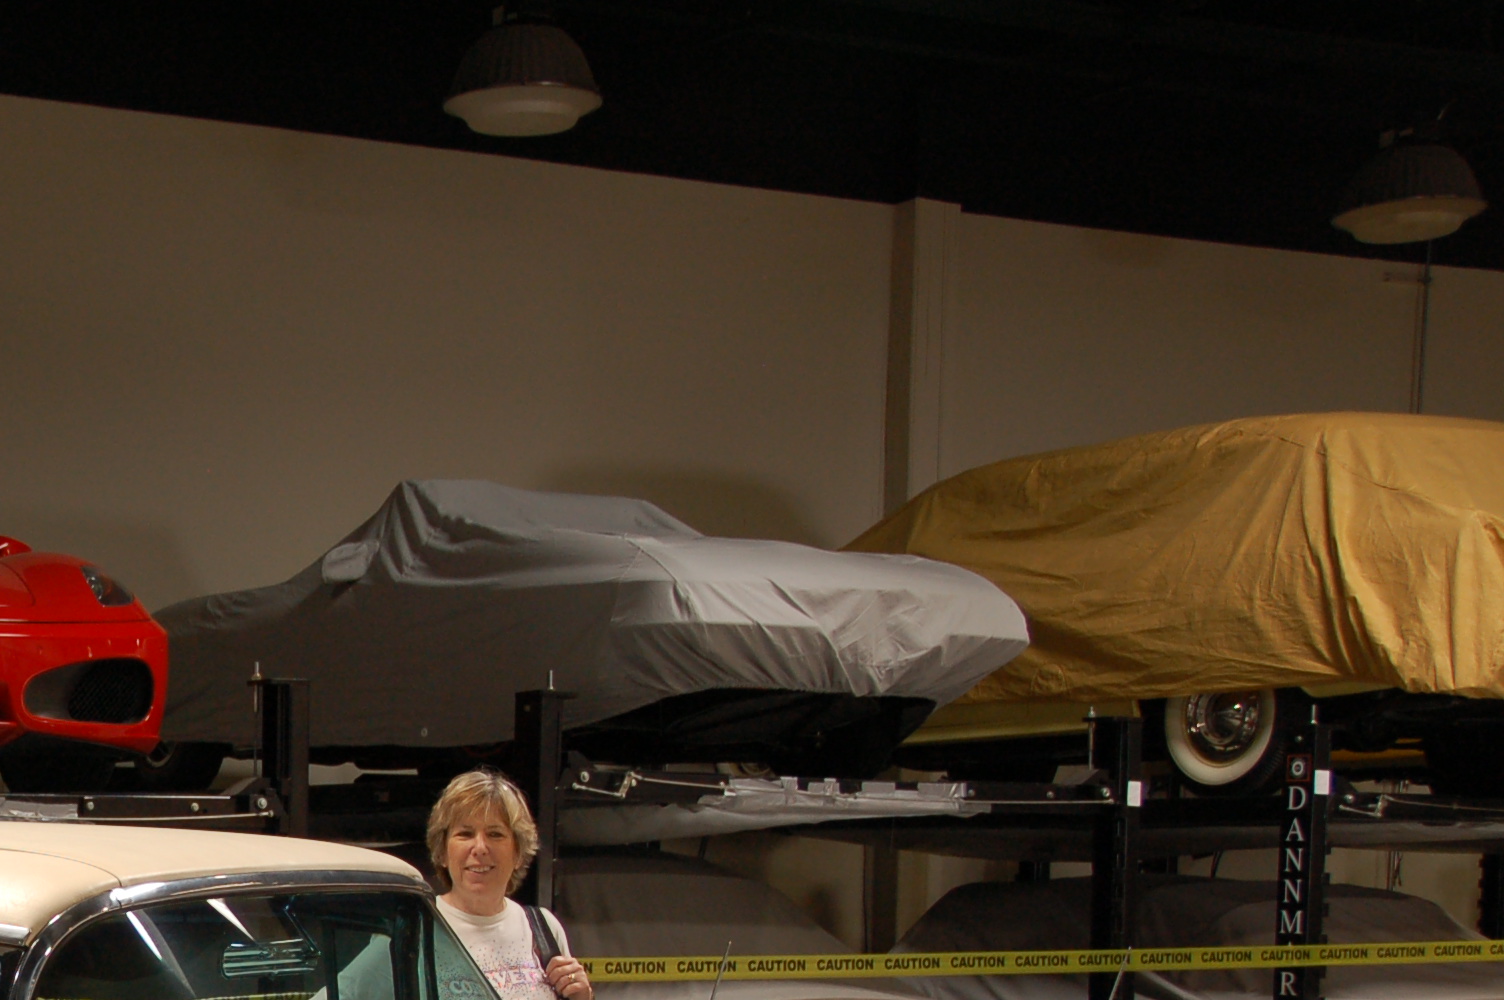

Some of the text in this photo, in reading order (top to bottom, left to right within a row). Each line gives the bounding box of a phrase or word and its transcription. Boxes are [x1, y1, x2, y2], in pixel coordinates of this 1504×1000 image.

[1279, 785, 1307, 997] DANNMR
[604, 961, 666, 975] CAUTION
[676, 960, 737, 973] CAUTION
[748, 959, 806, 972] CAUTION
[816, 958, 874, 971] CAUTION
[884, 957, 941, 970] CAUTION
[950, 956, 1005, 969] CAUTION
[1014, 954, 1069, 968] CAUTION
[1078, 953, 1131, 966] CAUTION
[1140, 952, 1192, 965] CAUTION
[1200, 951, 1252, 964] CAUTION
[1260, 949, 1310, 962] CAUTION
[1319, 948, 1369, 960] CAUTION
[1376, 946, 1426, 959] CAUTION
[1433, 944, 1482, 957] CAUTION
